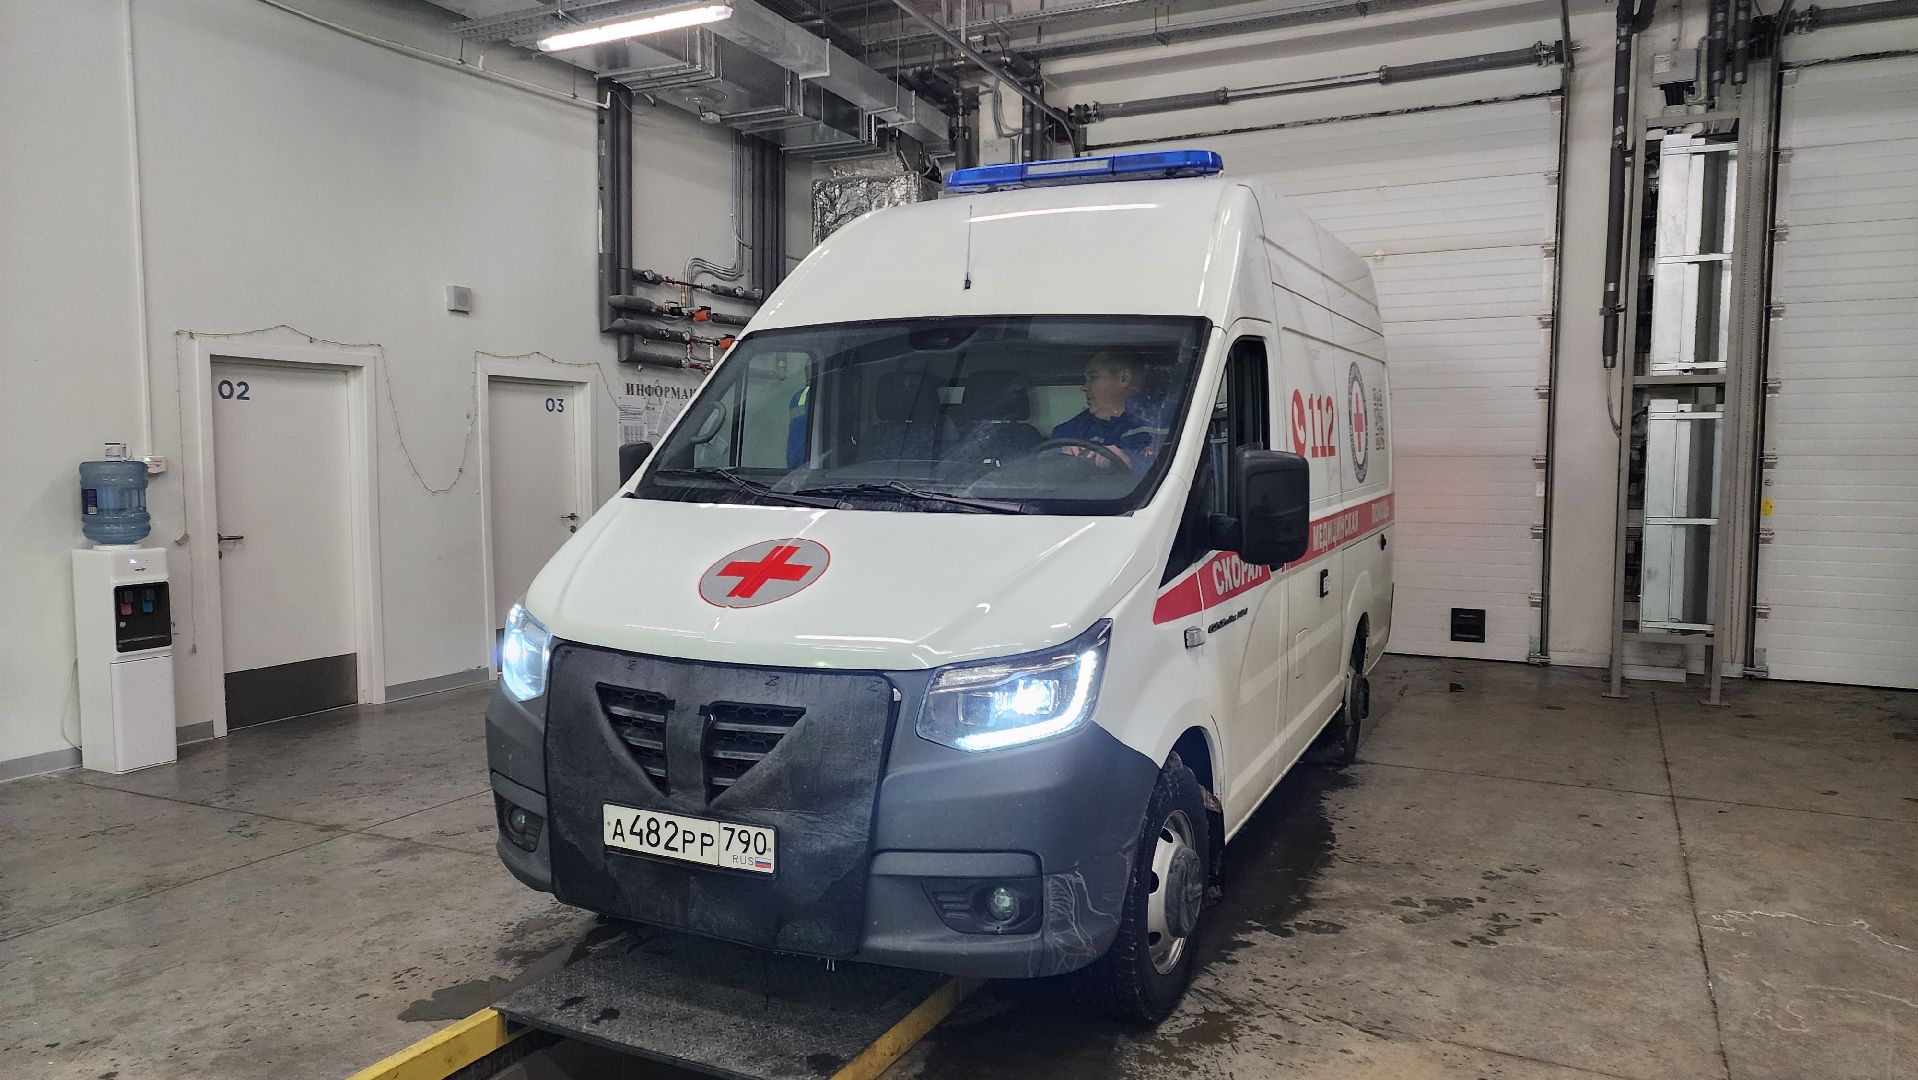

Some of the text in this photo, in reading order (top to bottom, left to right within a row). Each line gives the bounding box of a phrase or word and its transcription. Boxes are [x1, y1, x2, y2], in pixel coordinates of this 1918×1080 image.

[218, 379, 251, 401] 02
[545, 397, 565, 413] 03
[1308, 393, 1336, 458] 112
[722, 826, 767, 856] 790
[732, 854, 754, 866] RUS
